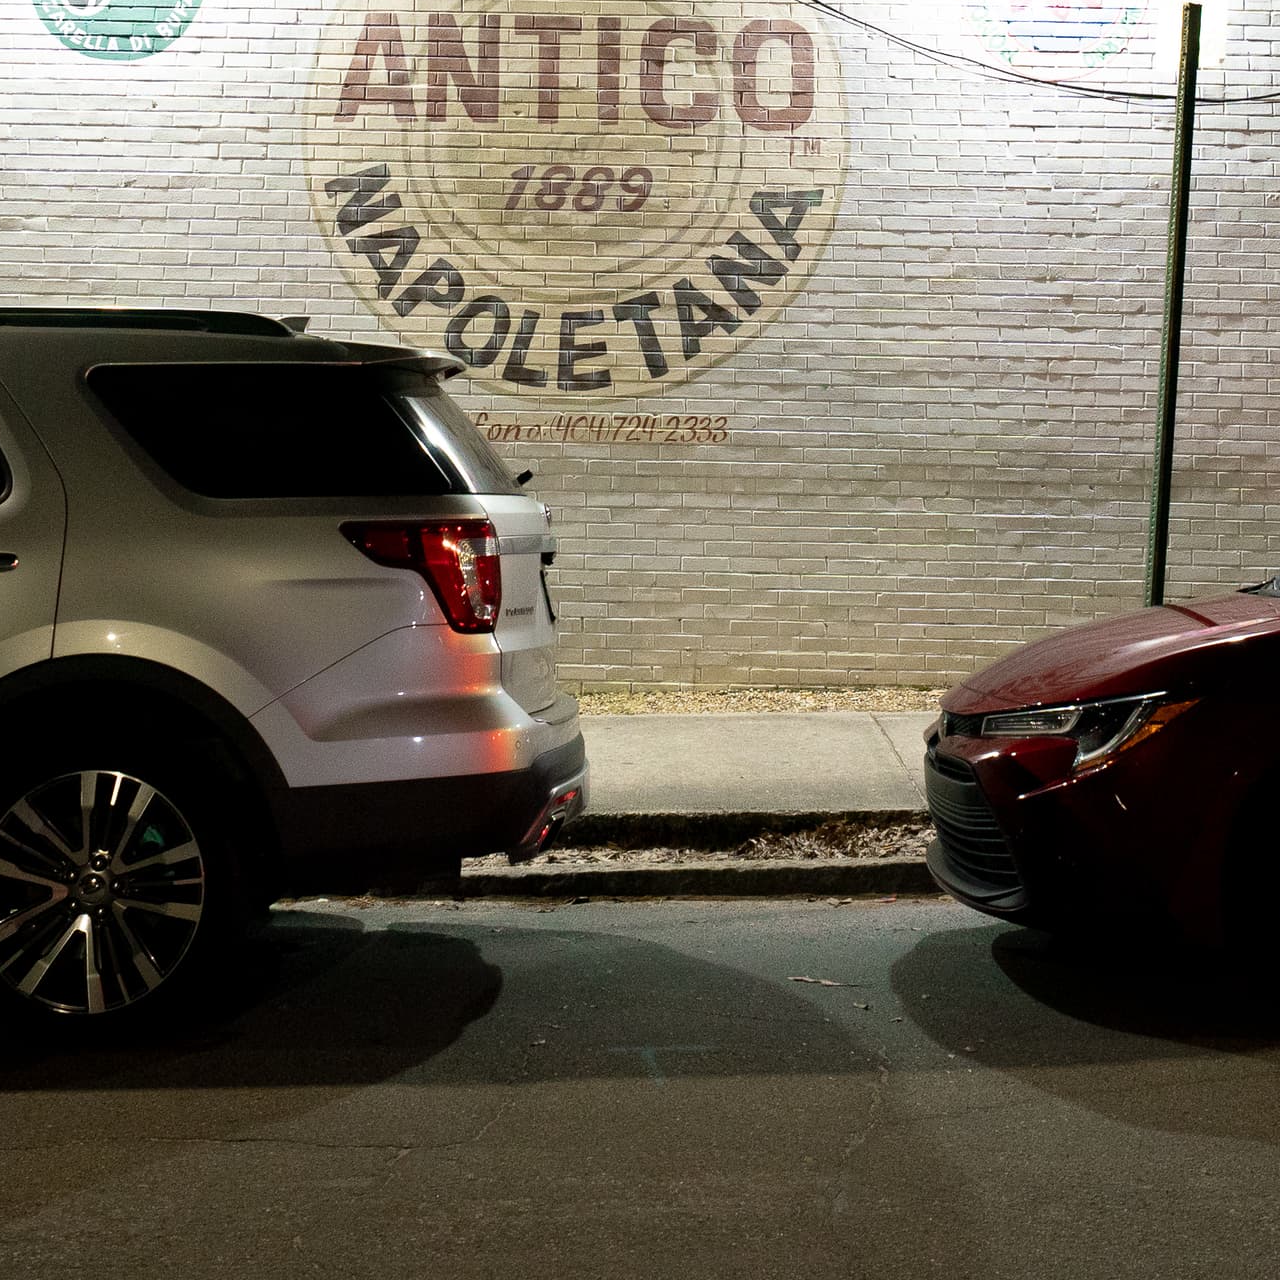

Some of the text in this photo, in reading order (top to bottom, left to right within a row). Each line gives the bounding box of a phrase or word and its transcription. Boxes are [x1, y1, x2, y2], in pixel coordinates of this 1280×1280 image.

[332, 12, 821, 132] ANTICO
[504, 165, 654, 213] 1889
[324, 163, 825, 391] NAPOLETANA
